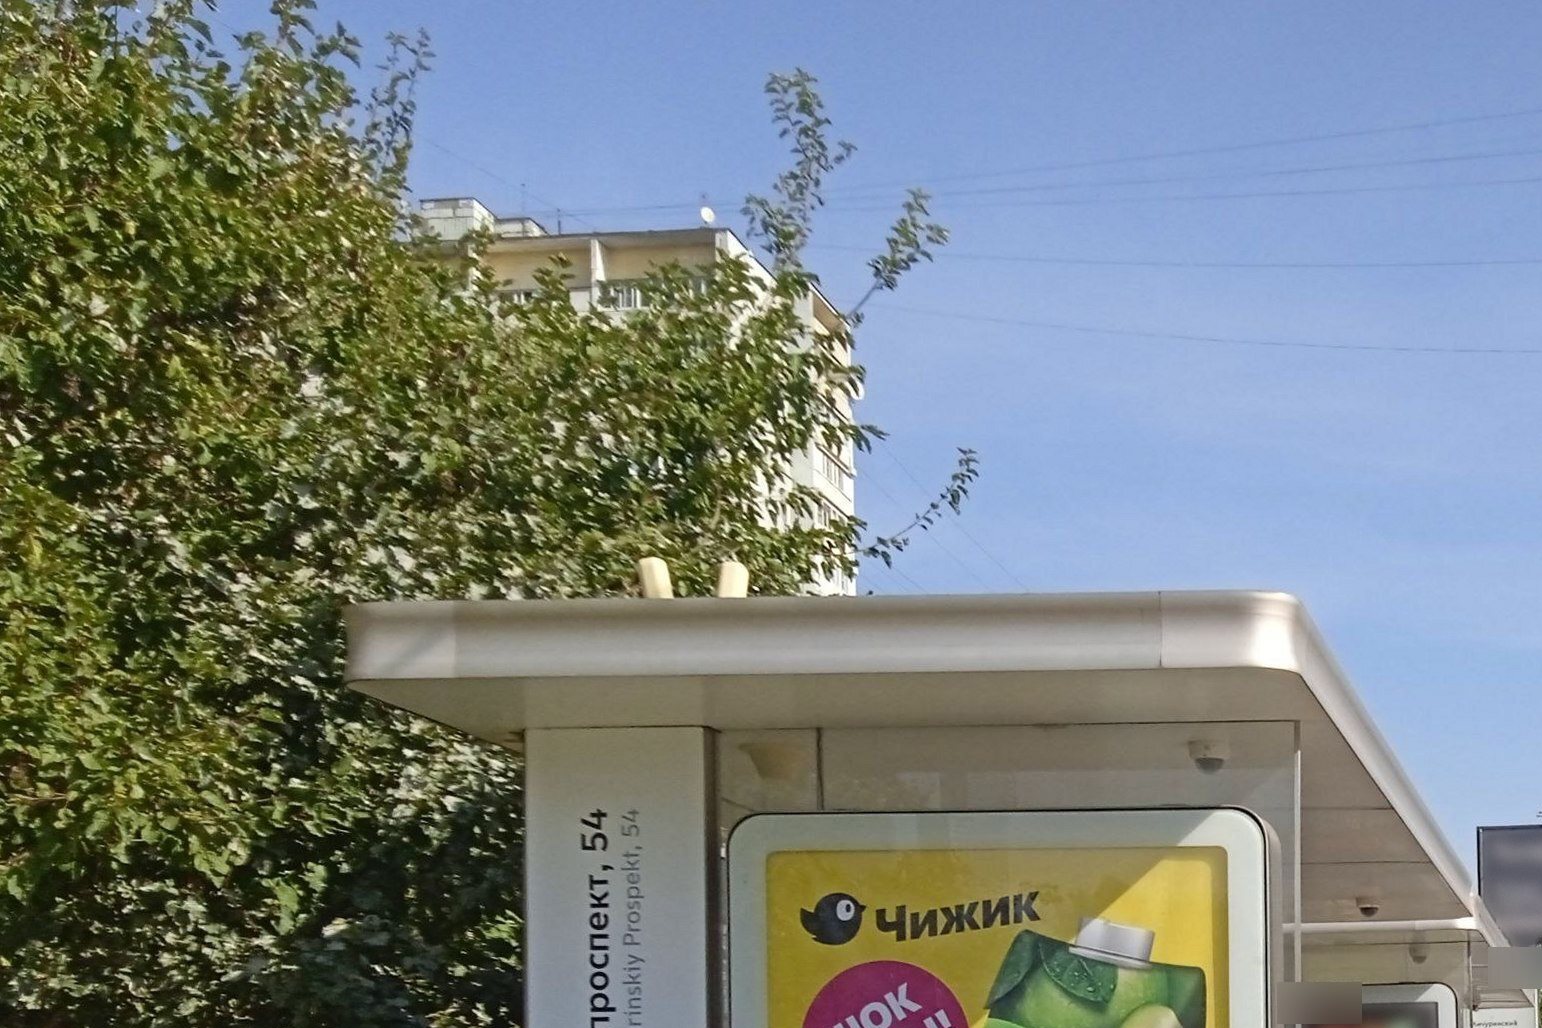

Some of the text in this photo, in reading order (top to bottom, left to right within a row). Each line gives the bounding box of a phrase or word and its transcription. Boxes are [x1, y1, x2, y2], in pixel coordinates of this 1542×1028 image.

[580, 808, 609, 851] 54
[620, 808, 641, 837] 54
[620, 845, 645, 946] Prospekt,
